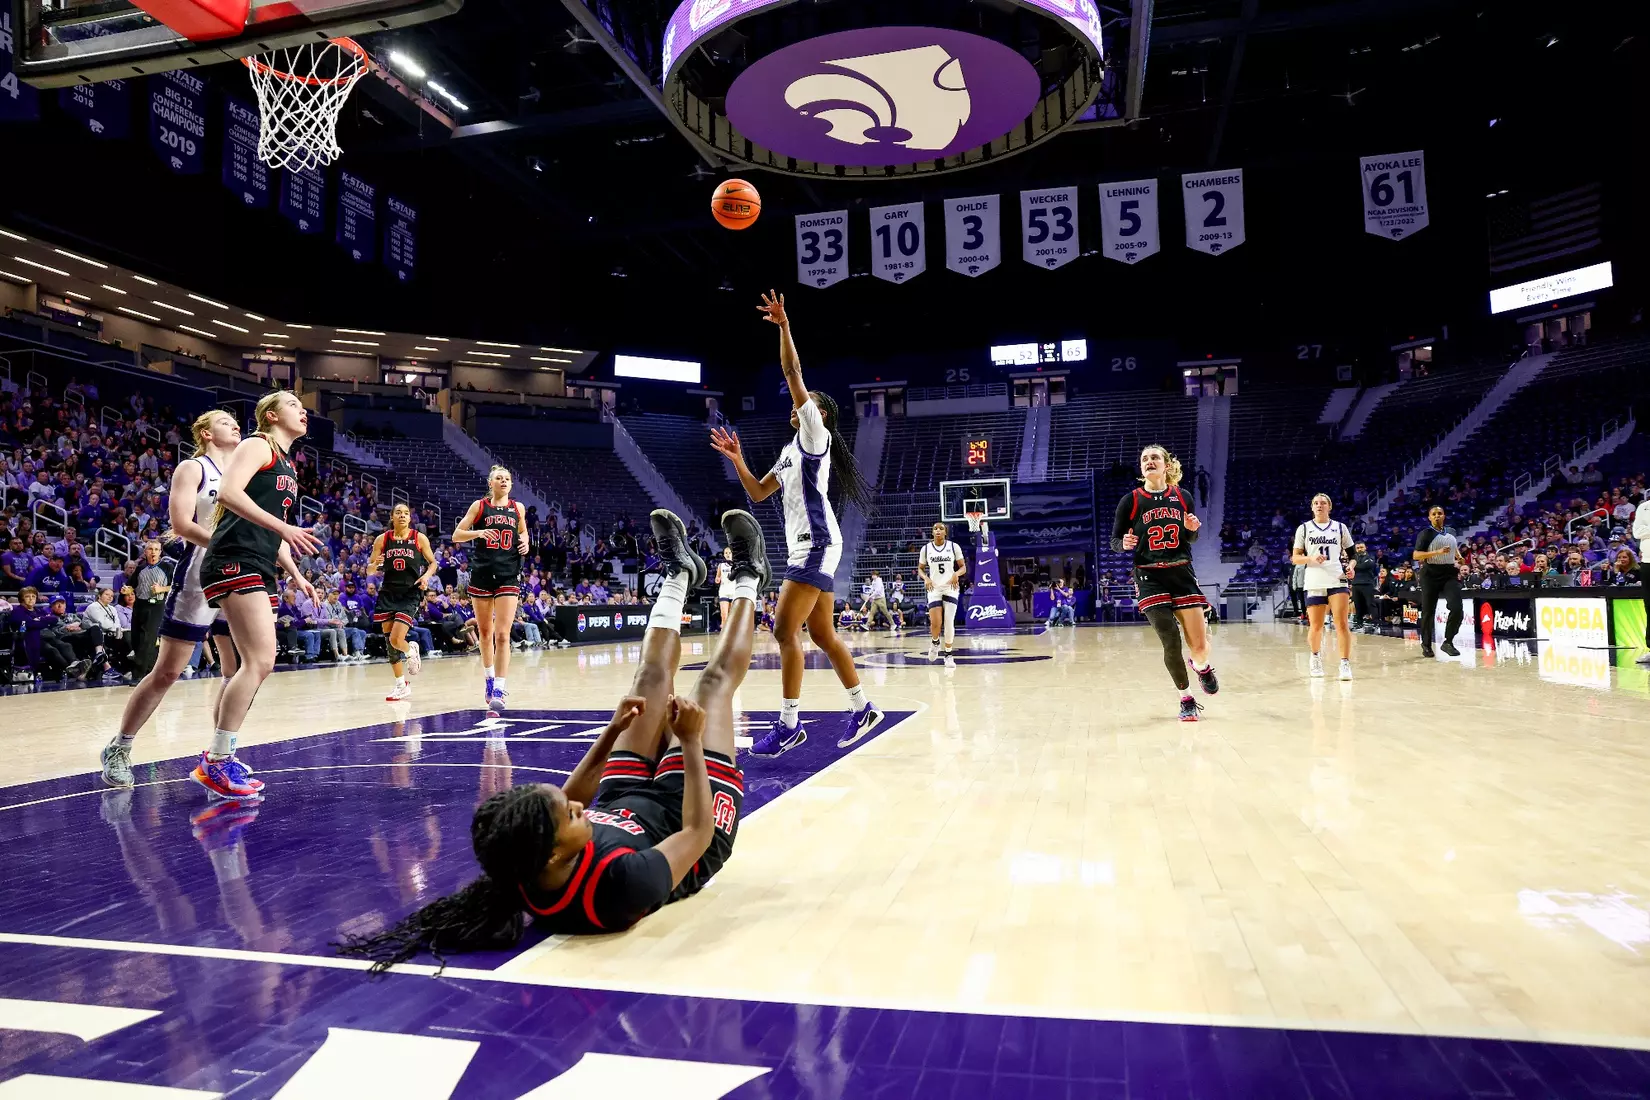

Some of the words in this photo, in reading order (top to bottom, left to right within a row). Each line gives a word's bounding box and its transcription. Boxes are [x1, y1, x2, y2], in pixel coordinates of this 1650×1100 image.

[73, 92, 94, 108] 2018
[165, 87, 182, 103] BIG
[182, 97, 193, 109] 12
[153, 92, 205, 126] CONFERENCE
[152, 101, 205, 138] CHAMPIONS
[159, 125, 196, 156] 2019
[1365, 161, 1400, 172] AYOKA
[1402, 158, 1421, 167] LEE
[341, 171, 375, 197] K-STATE
[1185, 175, 1240, 188] CHAMBERS
[1371, 171, 1413, 206] 61
[1029, 194, 1069, 204] WECKER
[1107, 186, 1150, 197] LEHNING
[388, 197, 417, 220] K-STATE
[956, 202, 988, 212] OHLDE
[1202, 191, 1227, 227] 2
[1388, 206, 1419, 214] DIVISION
[800, 217, 843, 228] ROMSTAD
[884, 210, 909, 220] GARY
[1119, 200, 1141, 236] 5
[963, 215, 984, 250] 3
[1028, 206, 1073, 244] 53
[876, 222, 920, 258] 10
[1199, 232, 1233, 241] 2009-13
[801, 229, 843, 264] 33
[1036, 248, 1067, 256] 2001-05
[1115, 241, 1147, 250] 2005-09
[884, 262, 914, 270] 1981-83
[958, 255, 989, 263] 2000-04
[808, 268, 837, 276] 1979-82
[1521, 281, 1553, 293] Friendly
[1556, 276, 1577, 285] Wins
[1526, 292, 1549, 302] Every
[1551, 287, 1572, 295] Time
[1020, 351, 1033, 361] 52
[1067, 347, 1081, 357] 65
[1297, 344, 1323, 360] 27
[1111, 357, 1137, 372] 26
[945, 368, 970, 383] 25
[968, 450, 986, 464] 24
[484, 514, 517, 529] UTAH
[1142, 507, 1181, 524] UTAH
[485, 529, 513, 550] 20
[1148, 524, 1179, 551] 23
[1309, 536, 1337, 545] Wildcats
[386, 548, 415, 559] UTAH
[1318, 546, 1330, 560] 11
[393, 558, 406, 572] 0
[938, 564, 945, 574] 5
[589, 616, 610, 628] PEPSI
[627, 615, 648, 626] PEPSI
[1494, 610, 1513, 633] Pizza
[1512, 611, 1531, 631] Hut
[1541, 606, 1604, 634] QDOBA
